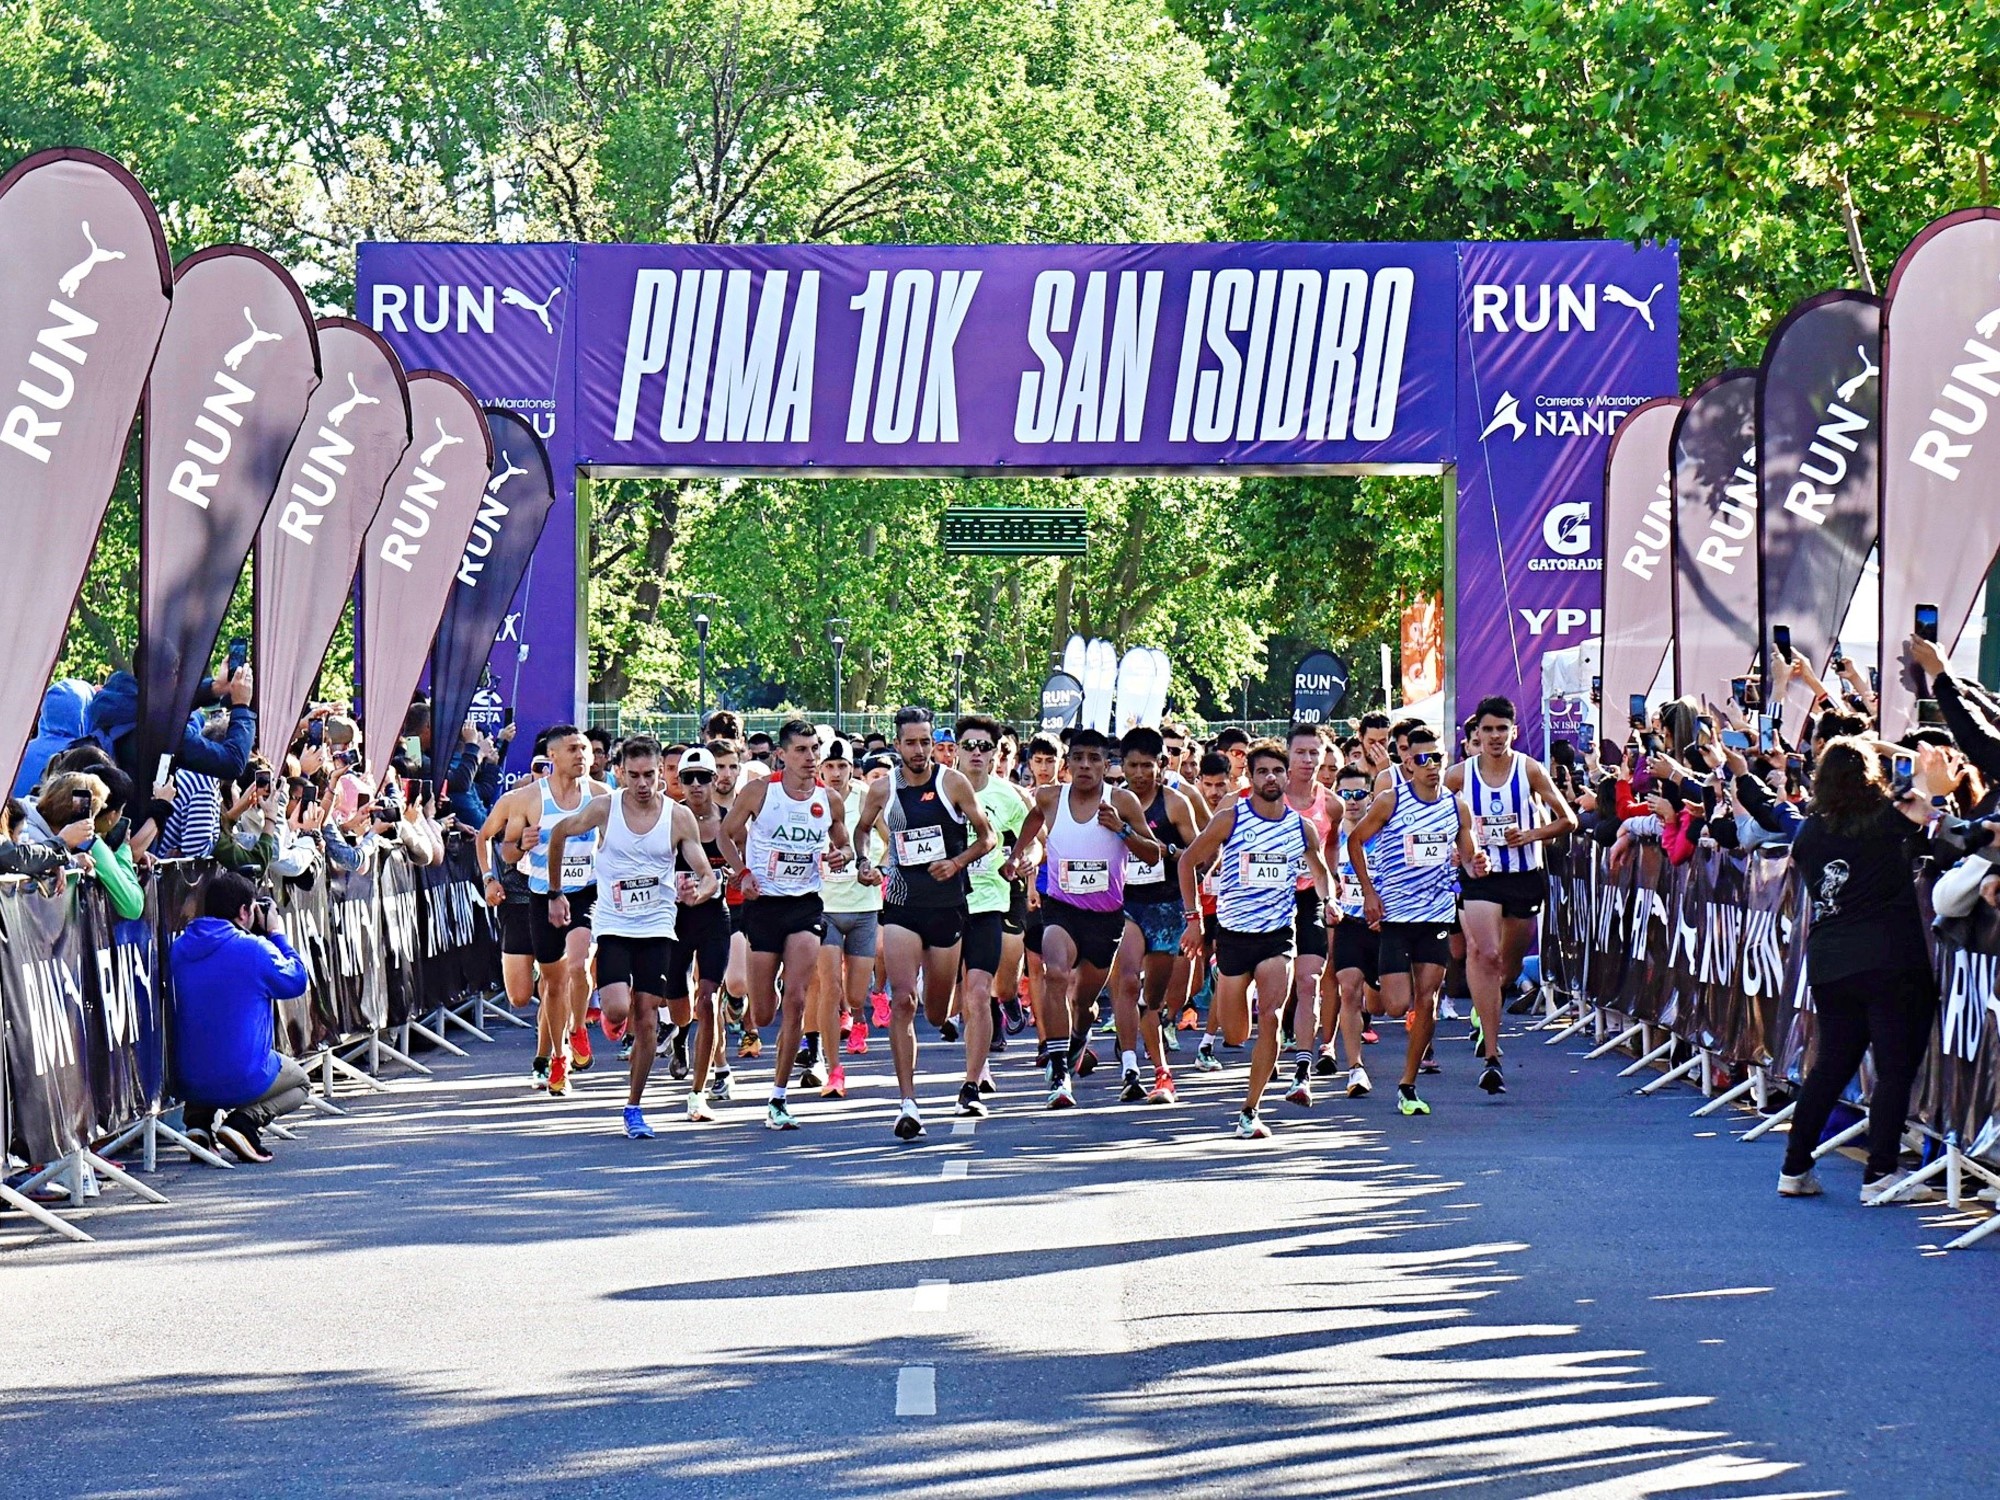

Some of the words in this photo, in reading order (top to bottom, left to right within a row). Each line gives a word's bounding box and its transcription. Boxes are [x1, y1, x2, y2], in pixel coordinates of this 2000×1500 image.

[372, 284, 494, 333] RUN
[1473, 283, 1596, 333] RUN
[614, 269, 820, 443] PUMA
[845, 269, 983, 443] 10K
[1013, 269, 1163, 443] SAN
[1168, 268, 1415, 443] ISIDRO
[0, 298, 100, 464] RUN
[494, 397, 556, 409] Maratones
[1535, 395, 1584, 407] Carreras
[1587, 397, 1594, 408] y
[1908, 338, 2000, 482] RUN
[167, 370, 257, 510] RUN
[1783, 403, 1870, 526] RUN
[278, 437, 356, 546] RUN
[380, 466, 447, 573] RUN
[1542, 501, 1592, 556] G
[1621, 484, 1672, 582] RUN
[1696, 467, 1758, 576] RUN
[456, 493, 510, 588] RUN
[1042, 690, 1071, 704] RUN
[1295, 673, 1331, 690] RUN
[1041, 716, 1064, 730] 4:30
[1292, 708, 1320, 724] 4:00
[771, 824, 823, 844] ADN
[917, 843, 932, 855] A4
[1425, 846, 1438, 857] A2
[563, 867, 584, 878] A60
[783, 865, 806, 876] A27
[1080, 874, 1096, 885] A6
[1138, 866, 1152, 876] A3
[1257, 867, 1279, 878] A10
[630, 890, 651, 903] A11
[97, 942, 140, 1052] RUN
[22, 957, 75, 1077] RUN
